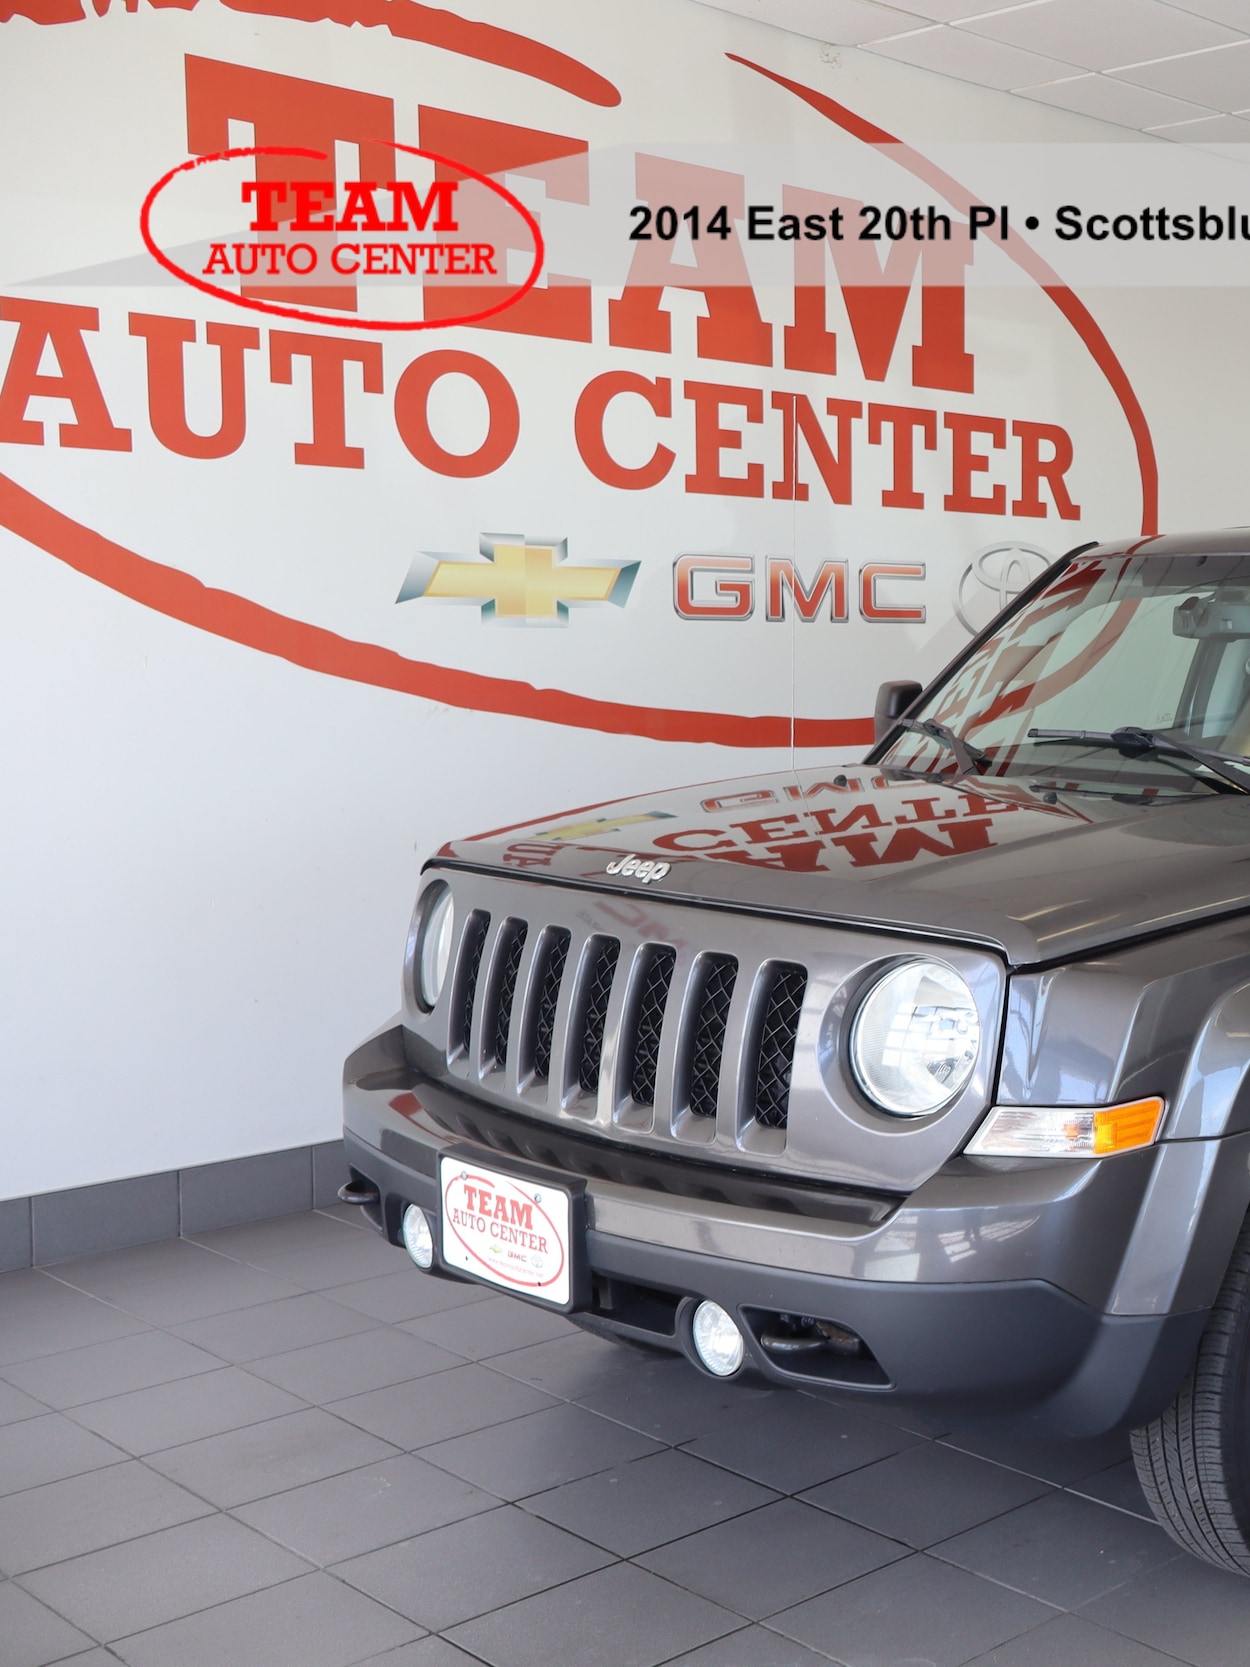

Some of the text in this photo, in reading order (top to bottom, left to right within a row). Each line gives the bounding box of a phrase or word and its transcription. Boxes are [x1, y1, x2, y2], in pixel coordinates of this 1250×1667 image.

[184, 54, 974, 394] TEAM
[0, 296, 1081, 521] AUTO CENTER
[673, 553, 926, 623] GMC
[606, 854, 672, 885] Jeep
[464, 1184, 534, 1230] TEAM
[453, 1208, 548, 1254] AUTO CENTER
[507, 1250, 528, 1262] GMC
